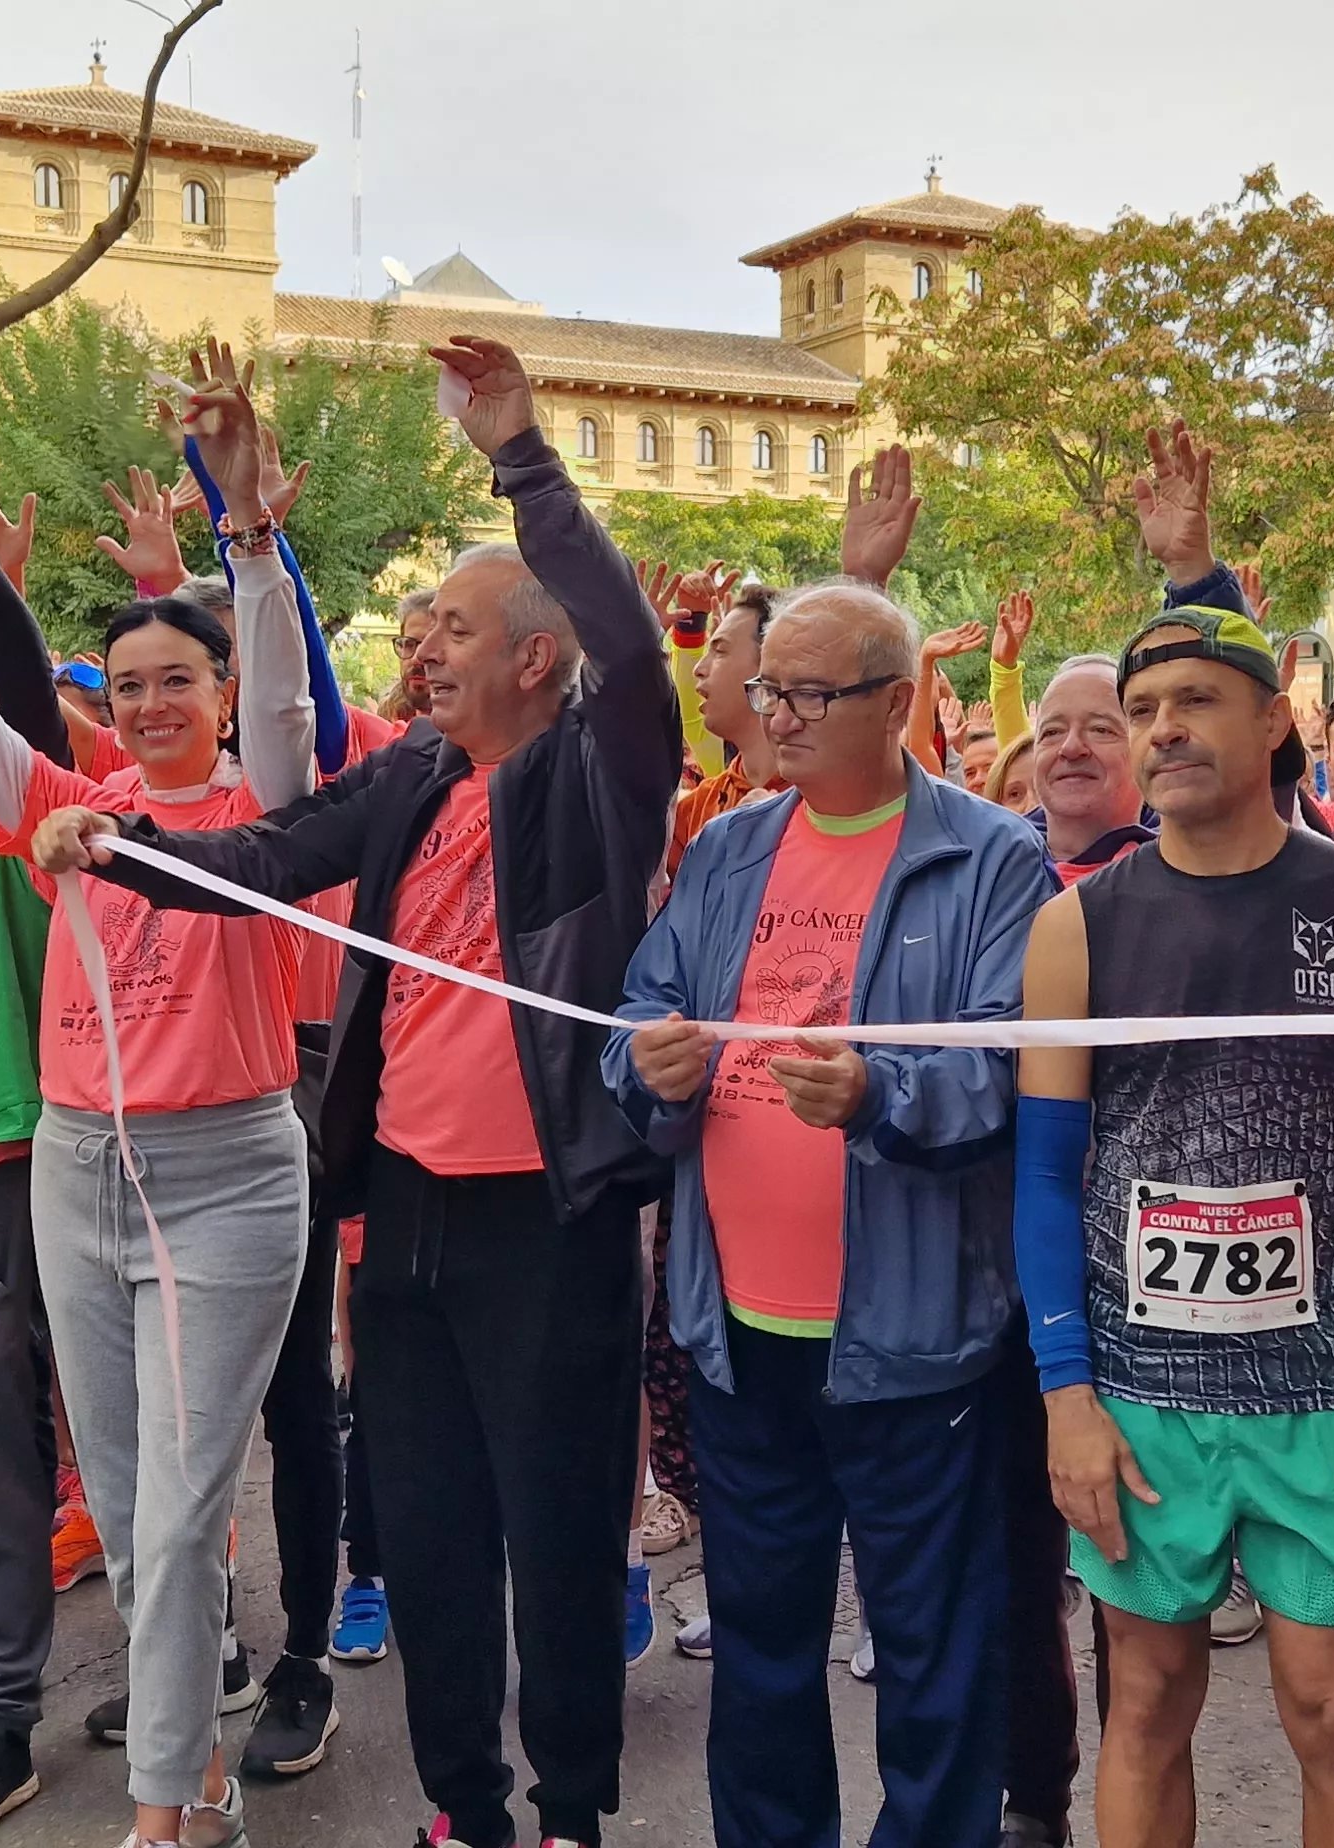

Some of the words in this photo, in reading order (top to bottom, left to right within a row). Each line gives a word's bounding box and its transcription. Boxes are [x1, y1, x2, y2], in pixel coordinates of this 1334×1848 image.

[755, 911, 786, 944] 9ª
[830, 931, 863, 943] HUES
[137, 974, 173, 988] MUCHO
[1199, 1205, 1246, 1218] HUESCA
[1149, 1211, 1211, 1233] CONTRA
[1216, 1219, 1233, 1233] EL
[1237, 1211, 1296, 1233] CÁNCER
[1143, 1235, 1298, 1296] 2782
